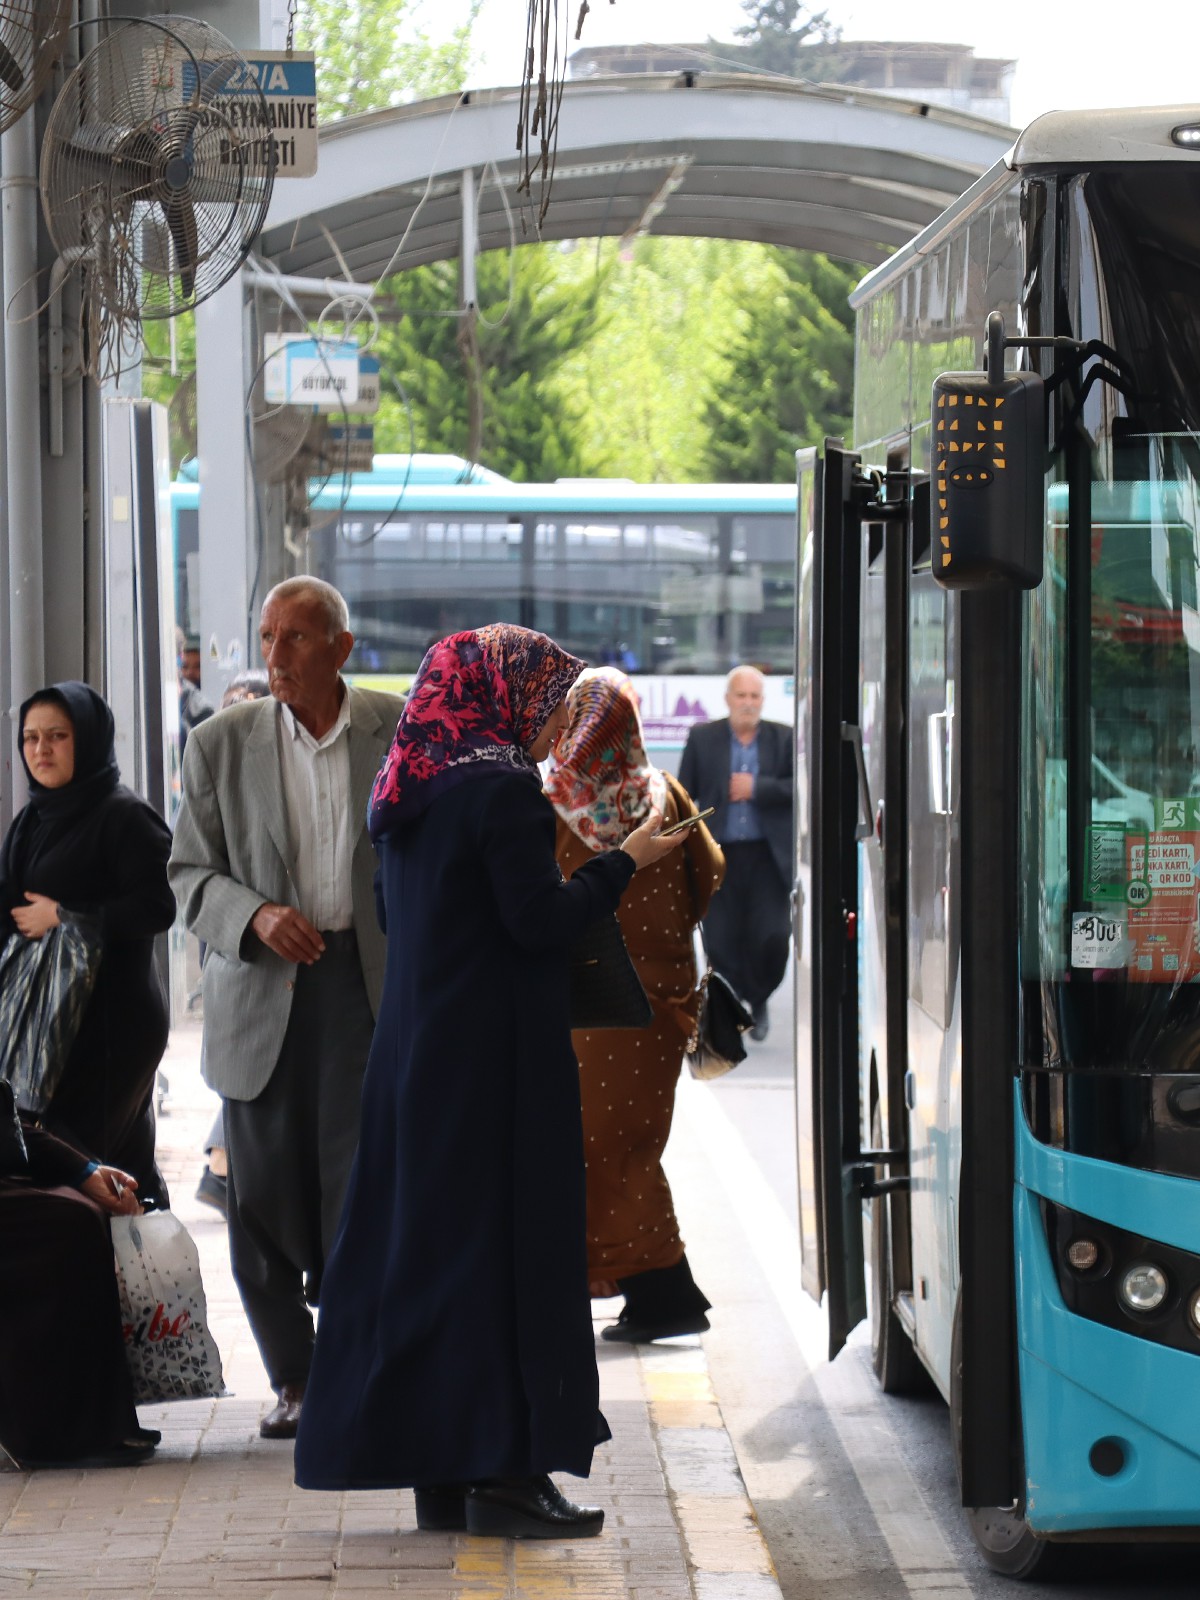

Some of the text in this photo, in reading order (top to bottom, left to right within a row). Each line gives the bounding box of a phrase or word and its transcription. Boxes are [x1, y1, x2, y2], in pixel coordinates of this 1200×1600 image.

[1159, 873, 1171, 884] QR
[1172, 873, 1191, 883] KOD
[1130, 887, 1146, 900] OK
